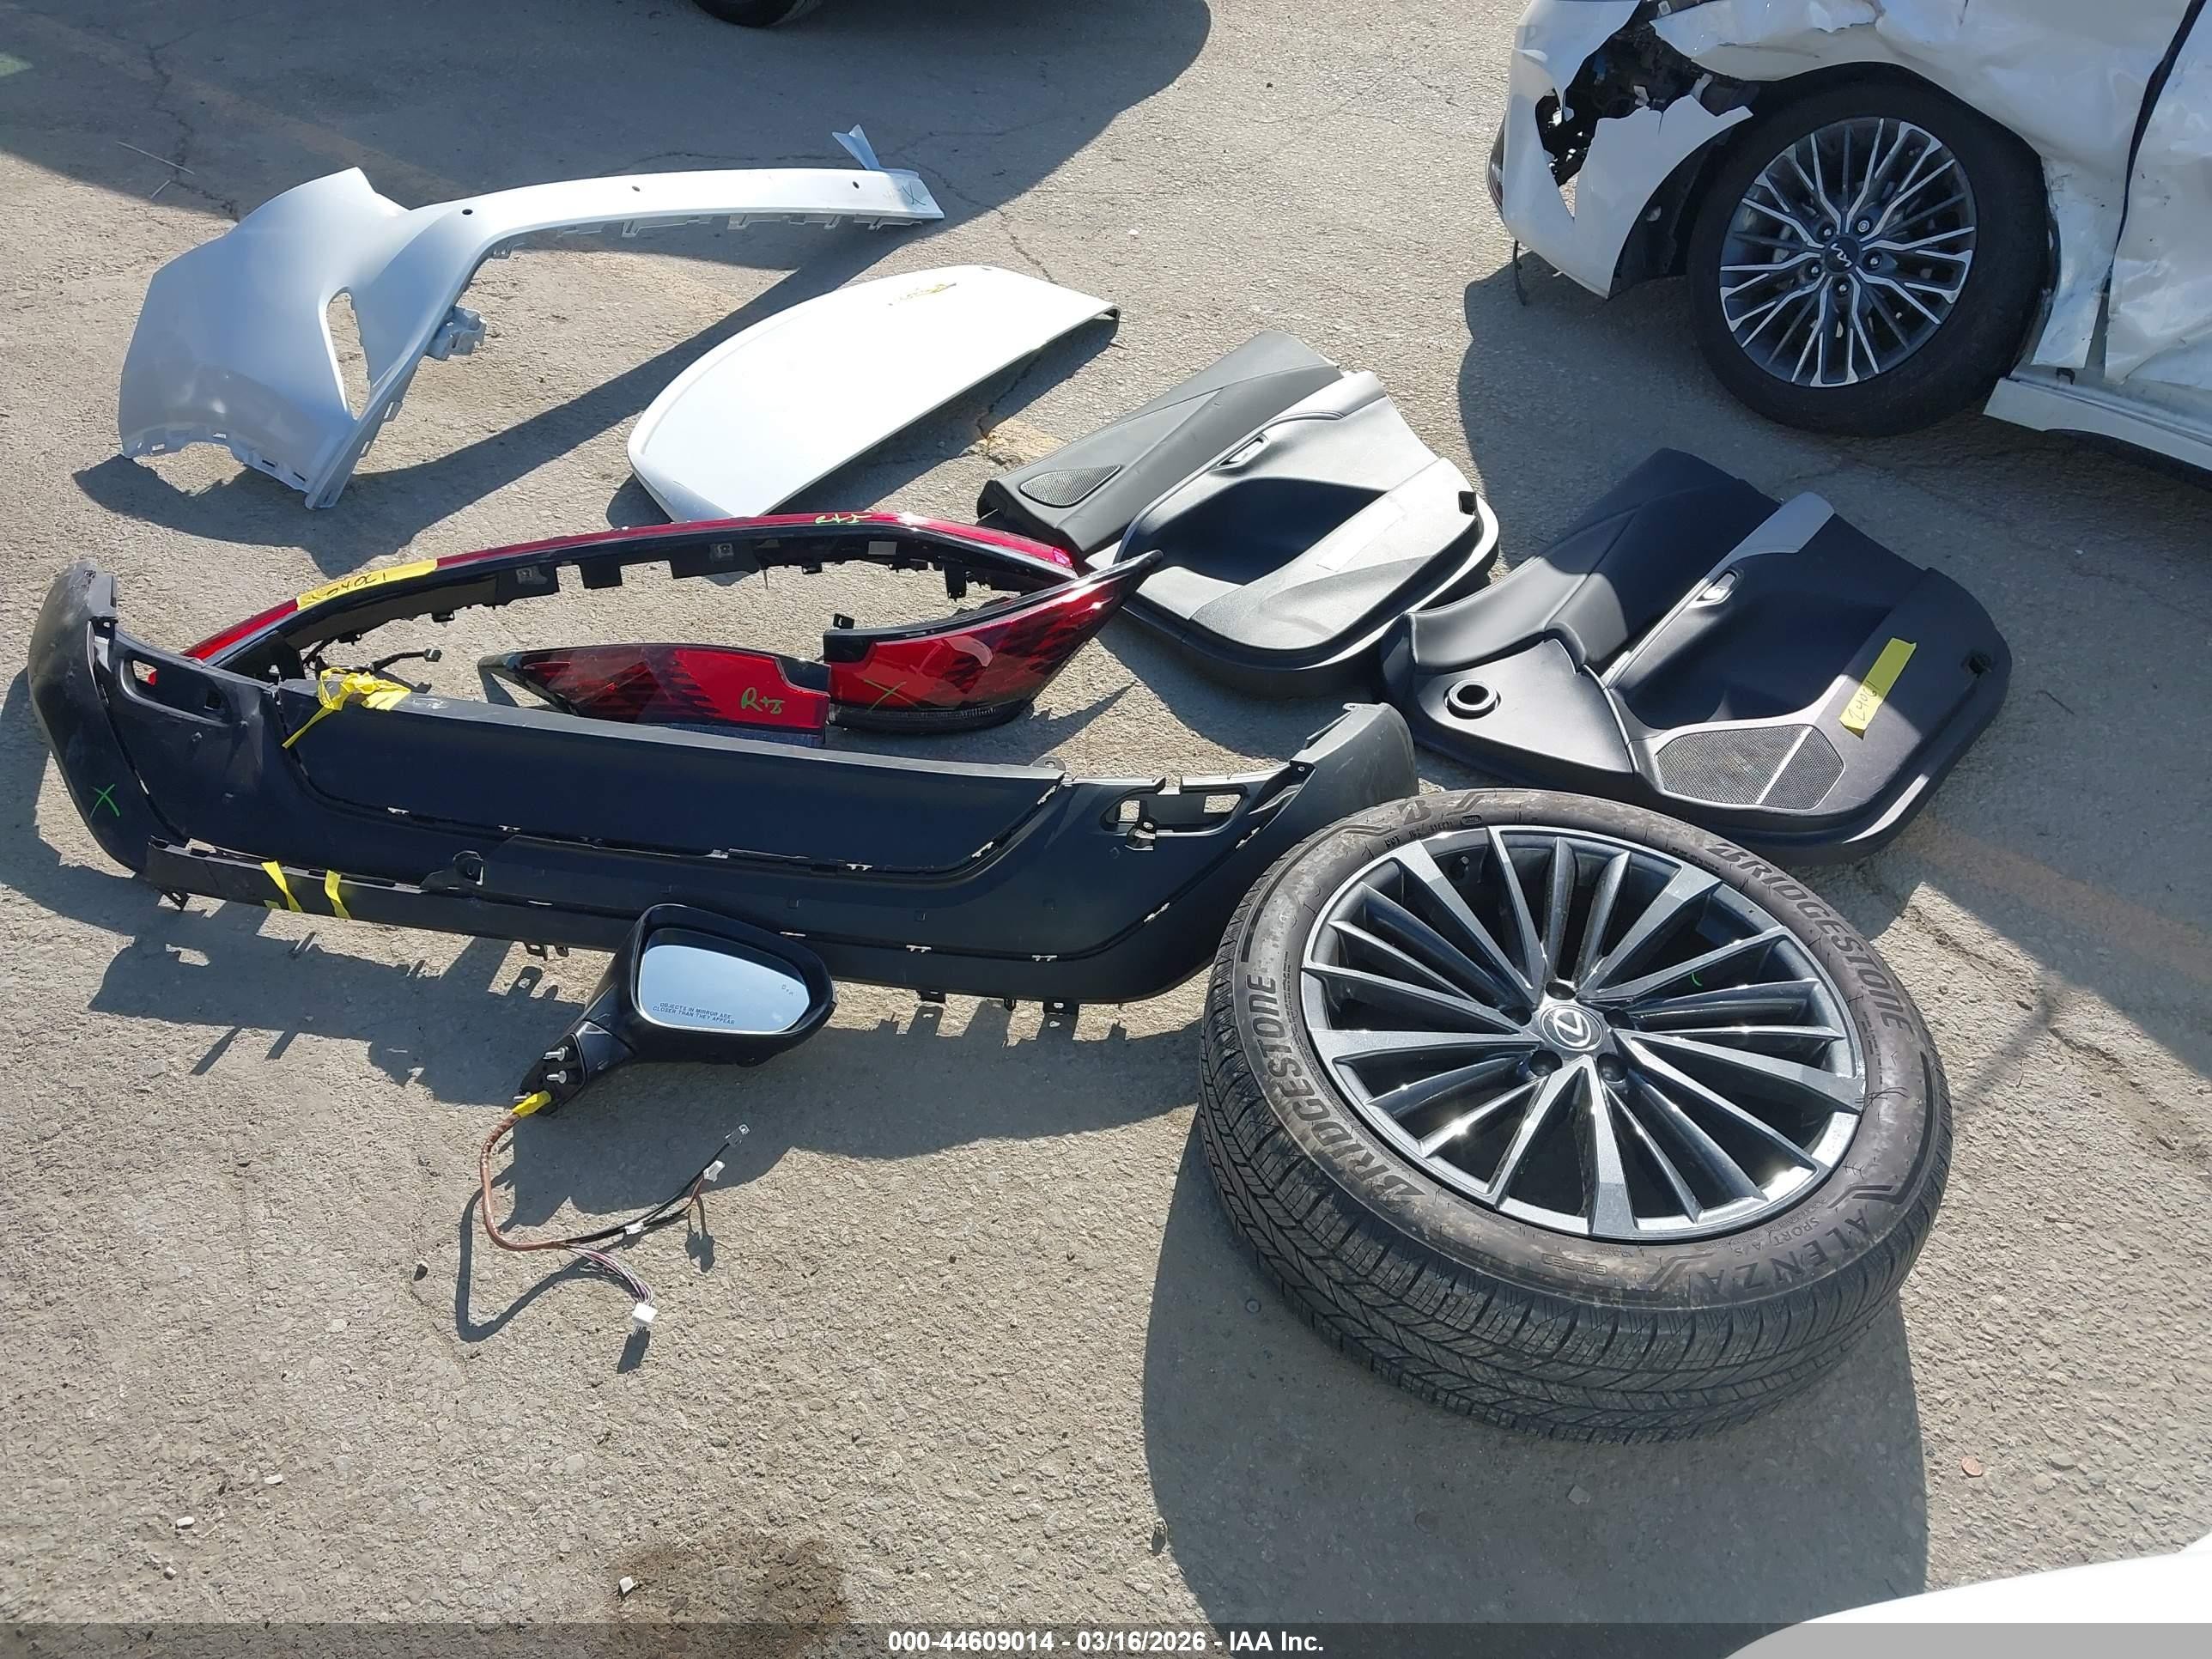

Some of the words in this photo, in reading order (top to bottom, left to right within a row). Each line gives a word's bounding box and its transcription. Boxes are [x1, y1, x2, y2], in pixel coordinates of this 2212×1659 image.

[1705, 842, 1915, 1035] BRIDGESTONE
[712, 1016, 736, 1024] APPEAR
[1247, 974, 1427, 1212] BRIDGESTONE
[1697, 1208, 1872, 1295] ALENZA
[1772, 1216, 1820, 1246] SPORT
